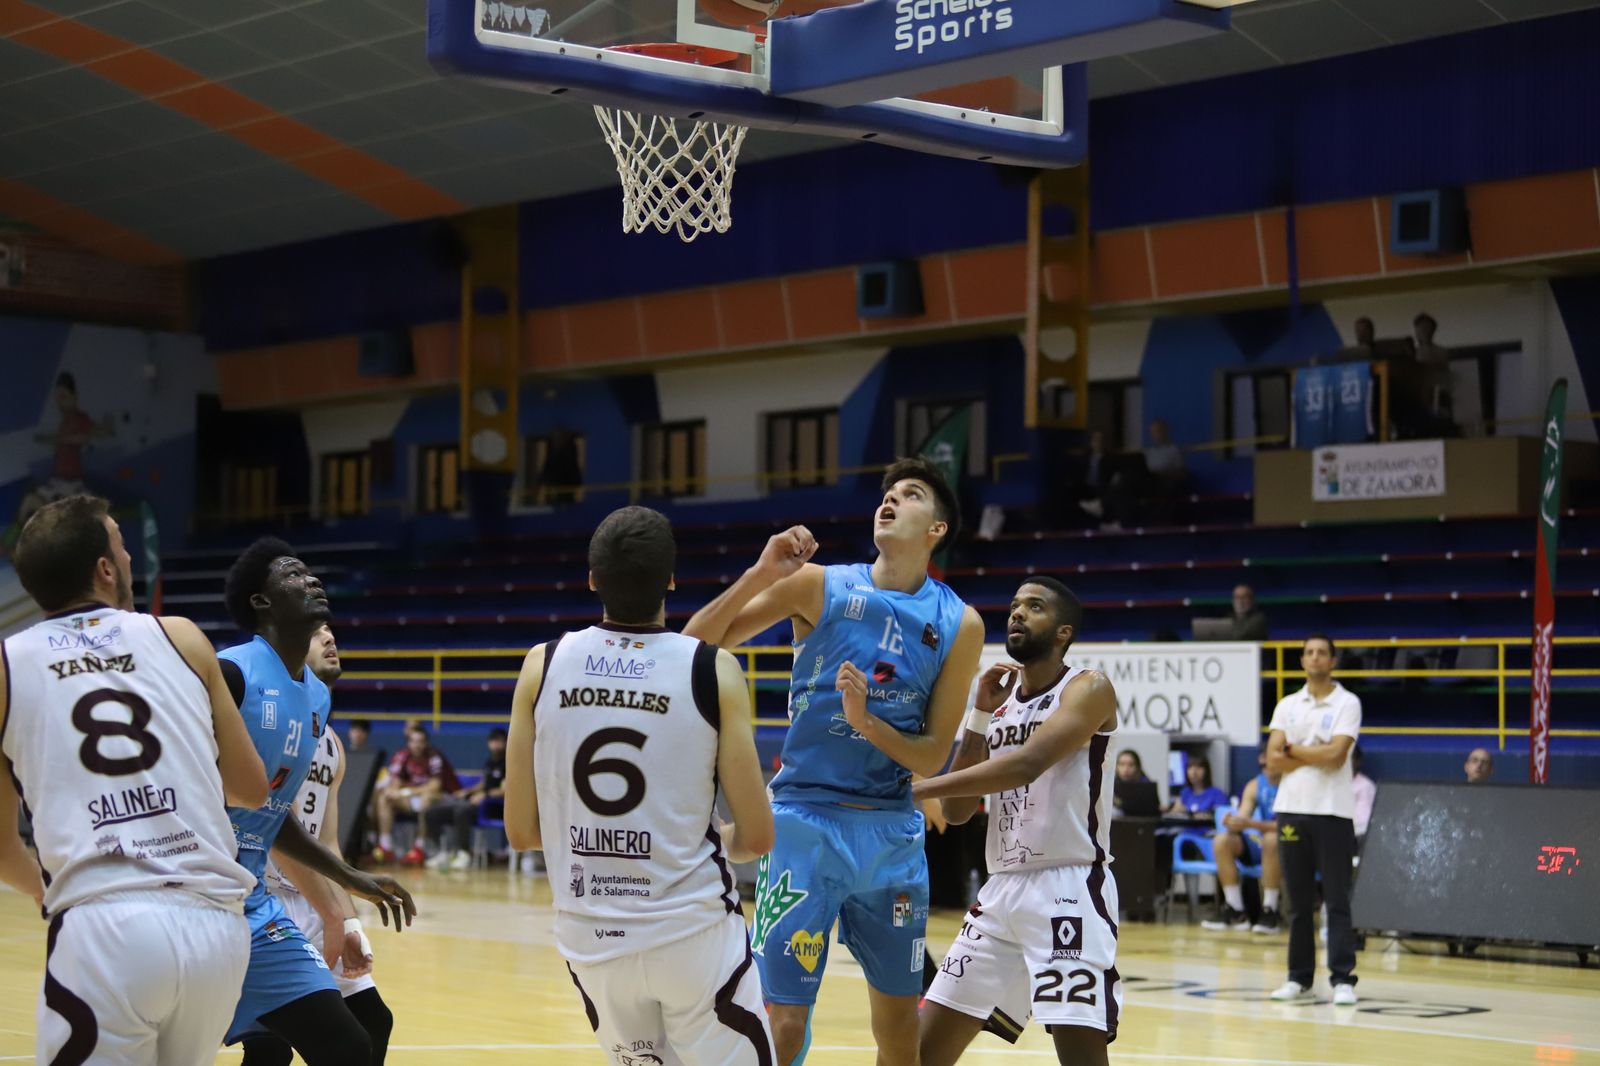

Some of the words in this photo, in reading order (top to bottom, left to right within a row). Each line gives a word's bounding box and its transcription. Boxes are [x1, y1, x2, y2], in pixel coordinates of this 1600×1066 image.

[895, 7, 1013, 54] Sports
[1343, 455, 1438, 473] AYUNTAMIENTO
[1342, 478, 1361, 494] DE
[1366, 474, 1437, 494] ZAMORA
[585, 655, 645, 677] MyMe
[559, 687, 671, 715] MORALES
[71, 688, 162, 776] 8
[284, 719, 303, 758] 21
[572, 726, 647, 817] 6
[303, 791, 316, 814] 3
[132, 830, 195, 848] Ayuntamiento
[150, 842, 199, 858] Salamanca
[570, 825, 651, 854] SALINERO
[591, 874, 651, 886] Ayuntamiento
[591, 886, 602, 896] de
[604, 886, 650, 897] Salamanca
[1033, 969, 1097, 1006] 22
